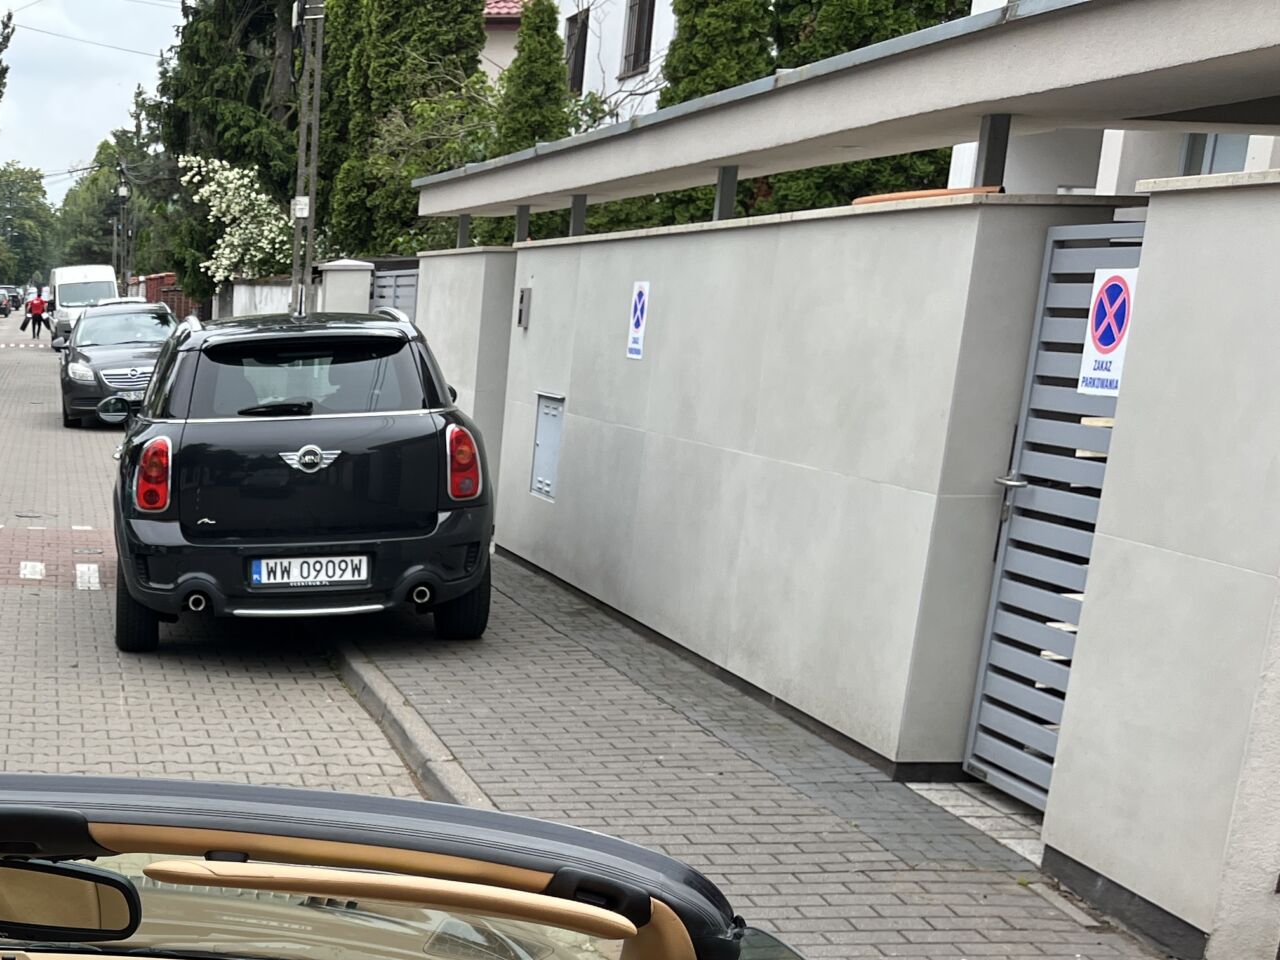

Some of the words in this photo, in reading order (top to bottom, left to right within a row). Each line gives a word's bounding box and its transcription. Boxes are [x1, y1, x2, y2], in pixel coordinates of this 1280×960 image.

[1093, 360, 1112, 372] ZAKAZ
[1081, 376, 1119, 390] PARKOWANIA
[266, 561, 292, 581] WW
[300, 558, 362, 580] 0909W
